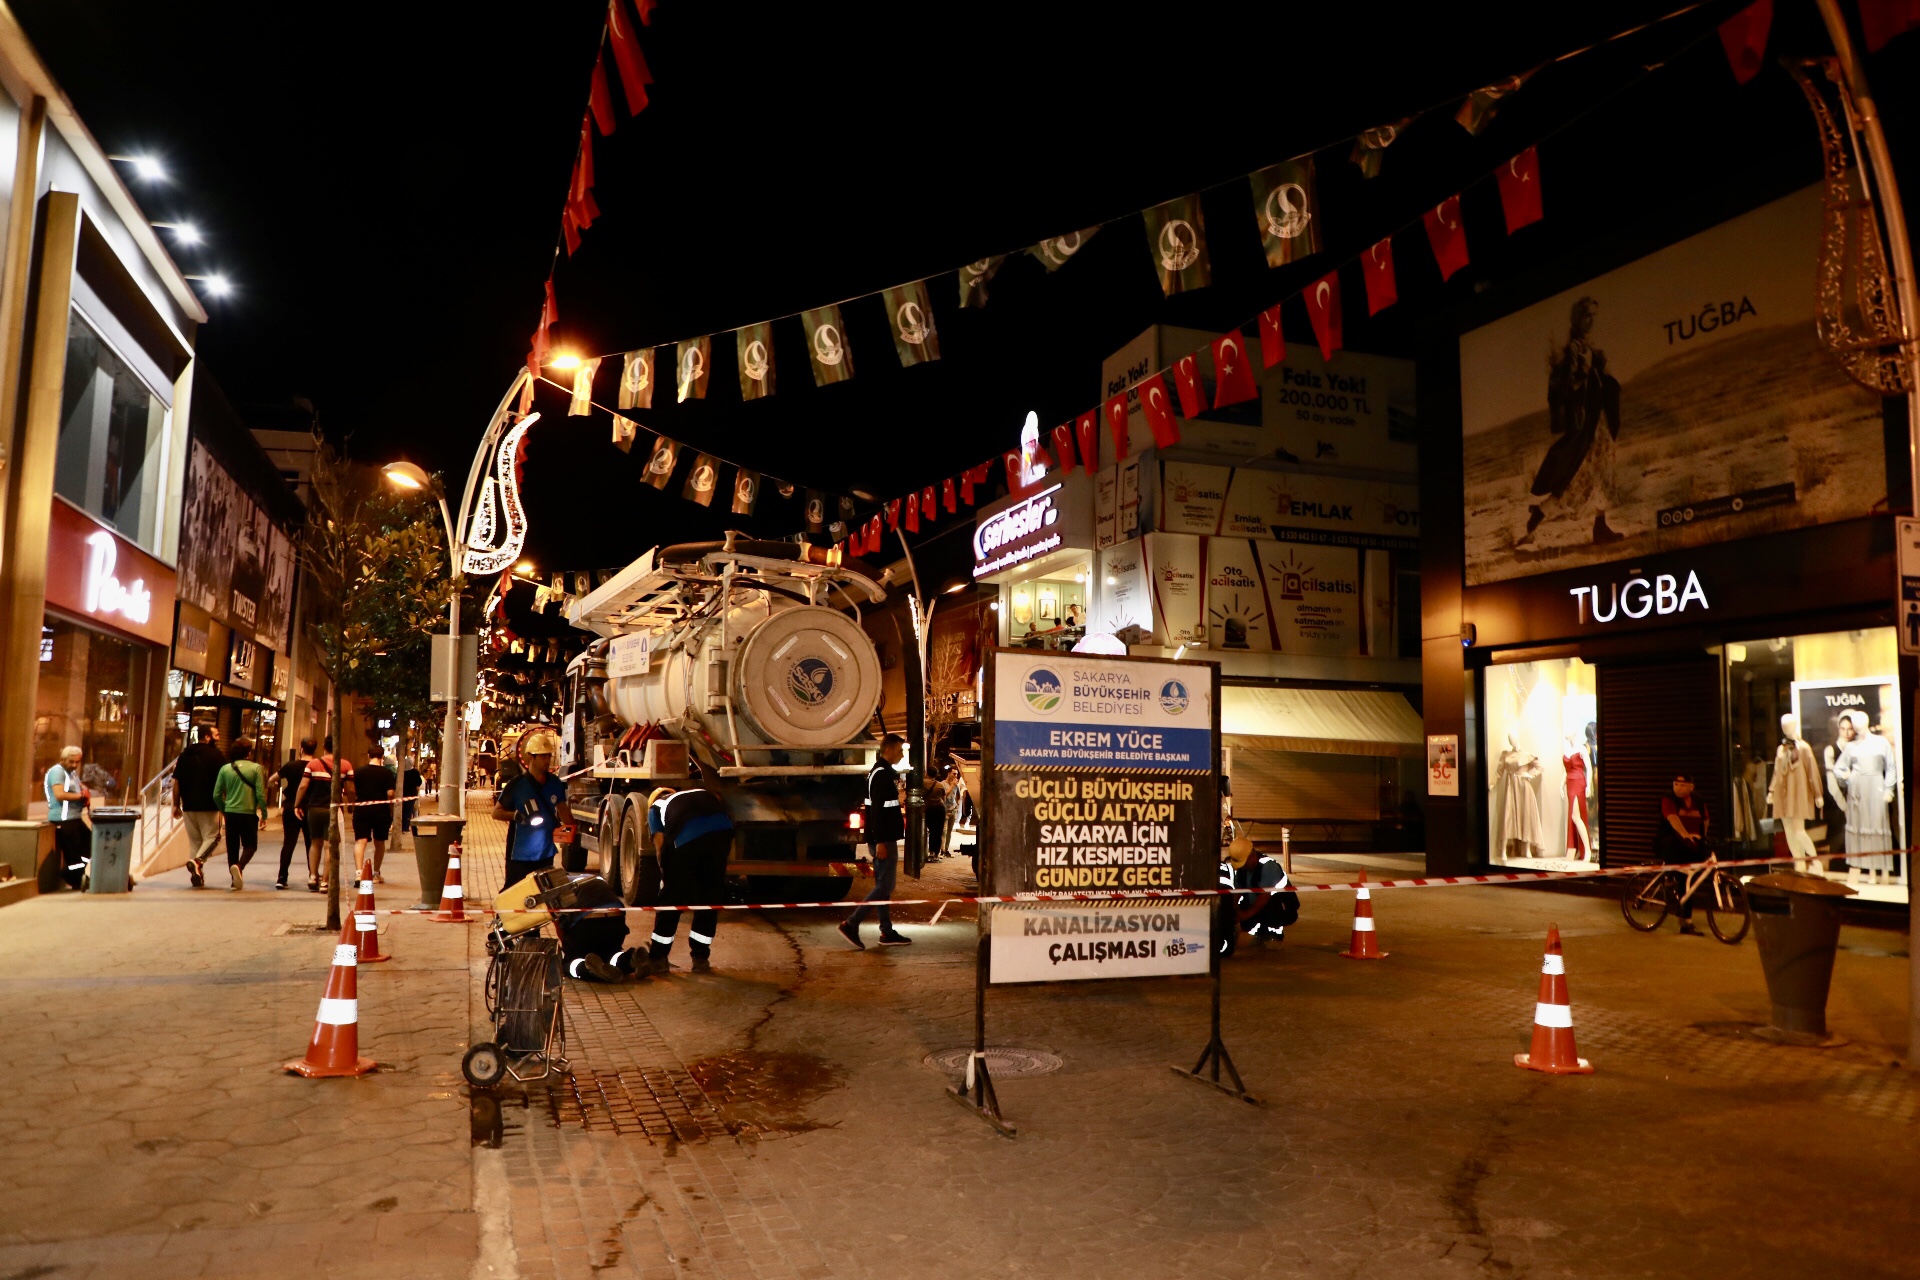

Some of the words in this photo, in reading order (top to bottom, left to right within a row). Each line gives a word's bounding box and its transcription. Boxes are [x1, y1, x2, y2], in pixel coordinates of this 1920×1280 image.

[1108, 376, 1126, 398] Faiz
[1127, 358, 1148, 384] Yok!
[1283, 368, 1321, 388] Faiz
[1326, 372, 1366, 394] Yok!
[1280, 389, 1348, 411] 200.000
[1352, 398, 1371, 414] TL
[1234, 515, 1262, 525] Emlak
[1290, 501, 1353, 521] EMLAK
[1223, 566, 1243, 576] Oto
[1211, 577, 1255, 588] acilsatis
[1569, 568, 1710, 625] TUĞBA
[1297, 605, 1331, 614] almanın
[1295, 617, 1334, 626] satmanın
[1073, 670, 1131, 684] SAKARYA
[1073, 684, 1151, 700] BÜYÜKŞEHİR
[1825, 693, 1865, 707] TUĞBA
[1073, 702, 1143, 715] BELEDİYESİ
[1050, 730, 1111, 747] EKREM
[1117, 730, 1163, 749] YÜCE
[1019, 748, 1059, 758] SAKARYA
[1061, 748, 1113, 760] BÜYÜKŞEHİR
[1115, 751, 1153, 761] BELEDİYE
[1155, 753, 1190, 762] BAŞKANI
[1015, 776, 1078, 801] GÜÇLÜ
[1082, 777, 1193, 802] BÜYÜKŞEHİR
[1034, 799, 1098, 825] GÜÇLÜ
[1101, 803, 1175, 822] ALTYAPI
[1040, 825, 1128, 843] SAKARYA
[1132, 822, 1168, 846] İÇİN
[1036, 847, 1068, 865] HIZ
[1072, 846, 1171, 865] KESMEDEN
[1036, 867, 1119, 887] GÜNDÜZ
[1122, 867, 1172, 887] GECE
[1023, 912, 1180, 936] KANALİZASYON
[1049, 940, 1156, 965] ÇALIŞMASI
[1167, 943, 1186, 957] 185
